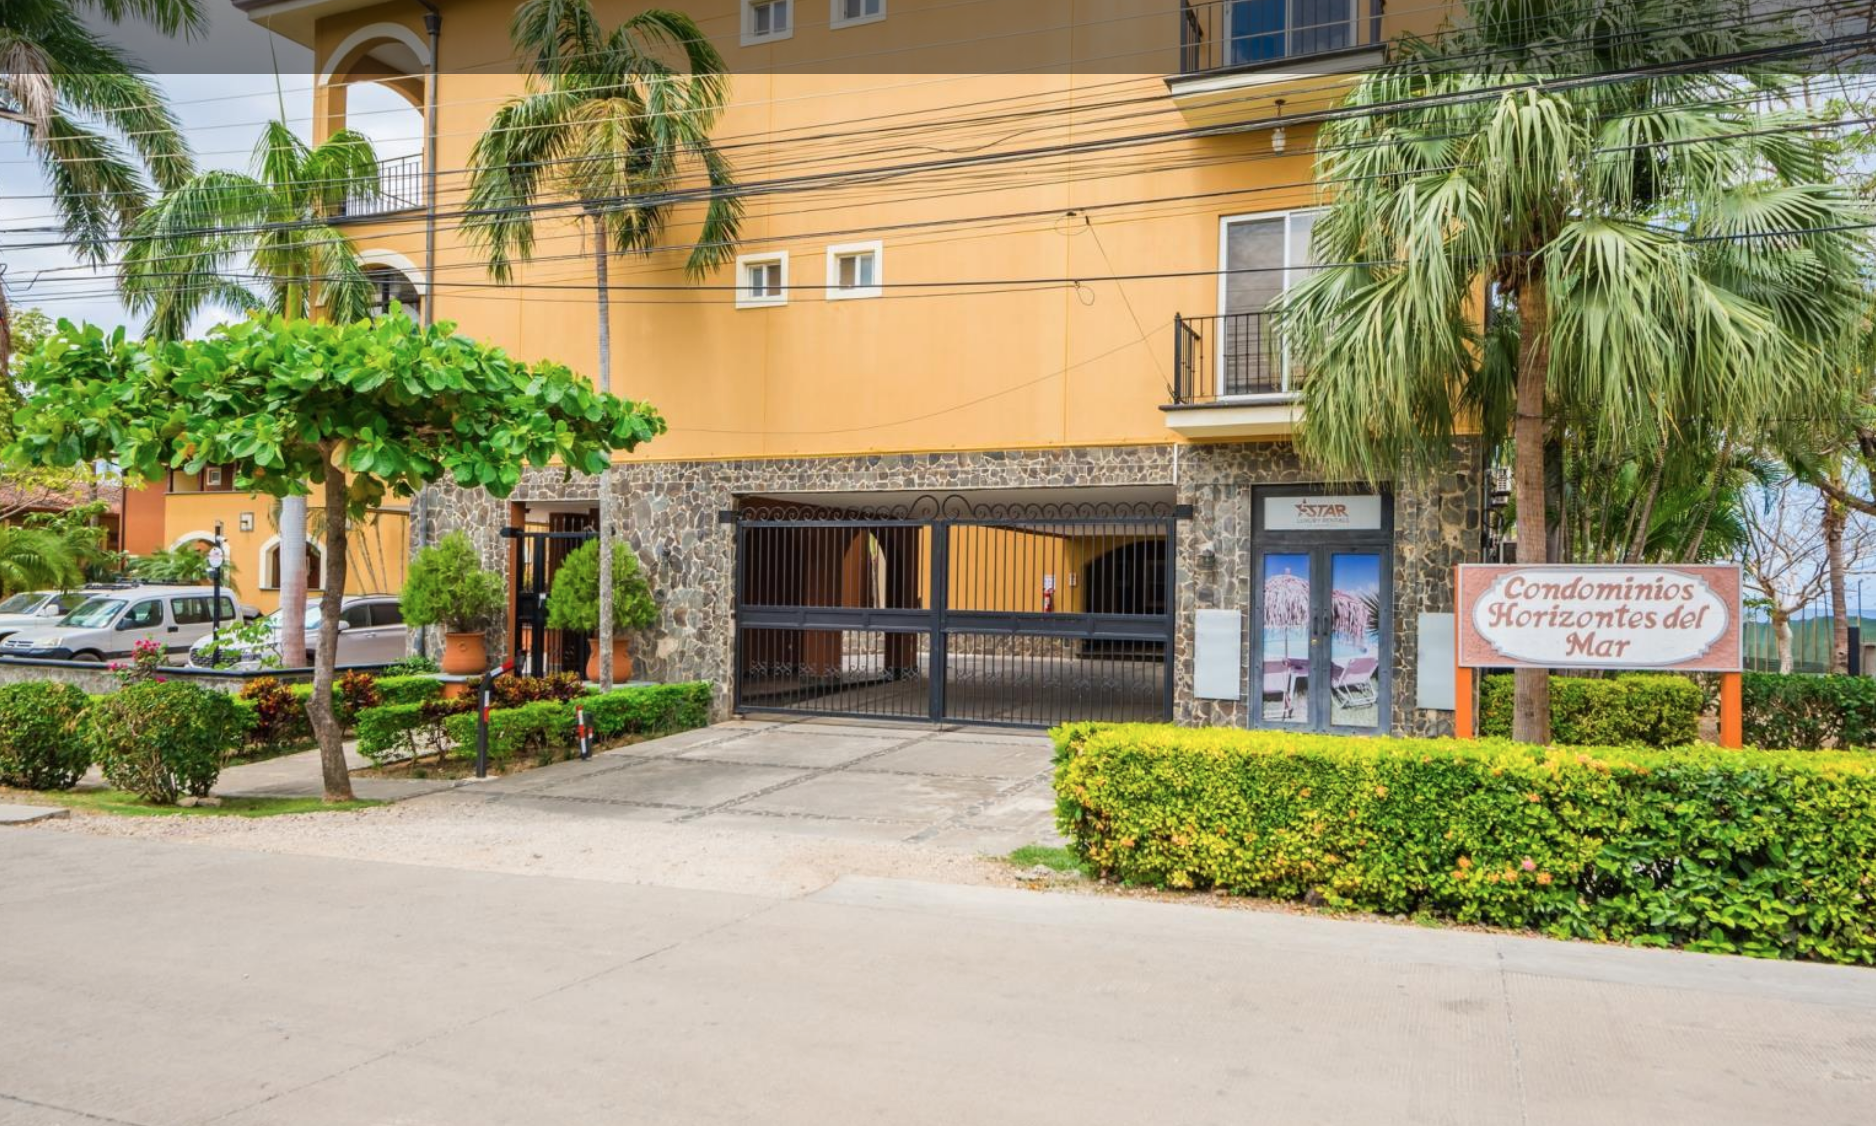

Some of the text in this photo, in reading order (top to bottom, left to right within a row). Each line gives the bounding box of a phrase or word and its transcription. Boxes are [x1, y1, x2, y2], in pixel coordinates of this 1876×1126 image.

[1504, 576, 1694, 600] Condominios
[1488, 602, 1710, 629] Horizontes del
[1565, 632, 1631, 658] Mar
